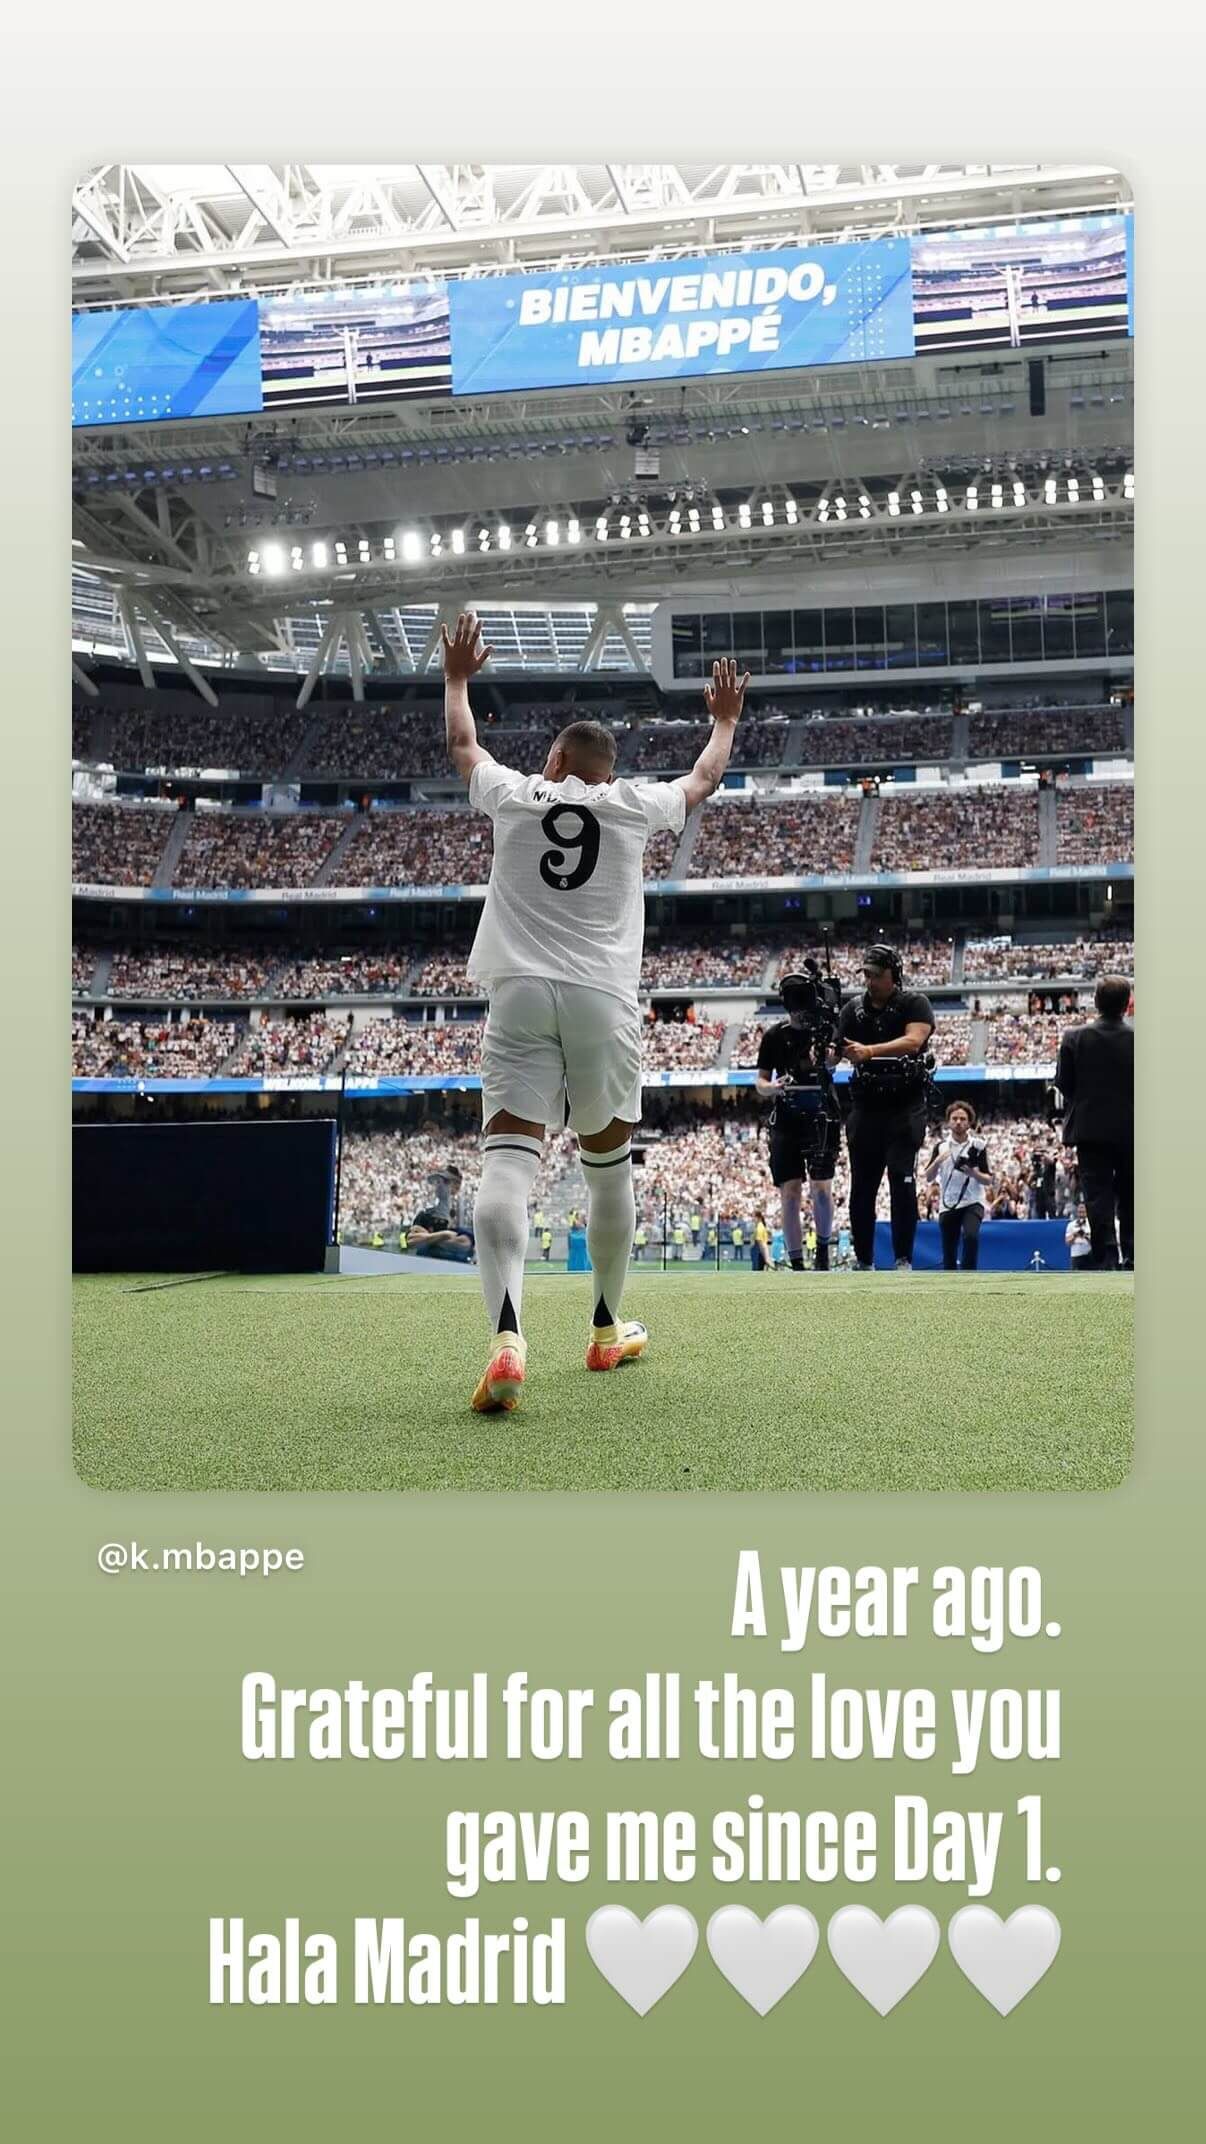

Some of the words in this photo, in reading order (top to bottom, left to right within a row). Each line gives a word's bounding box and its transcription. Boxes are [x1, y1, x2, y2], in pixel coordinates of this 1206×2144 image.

[519, 262, 838, 326] BIENVENIDO,
[577, 305, 782, 368] MBAPPÉ
[539, 803, 601, 891] 9
[735, 880, 768, 889] Madrid
